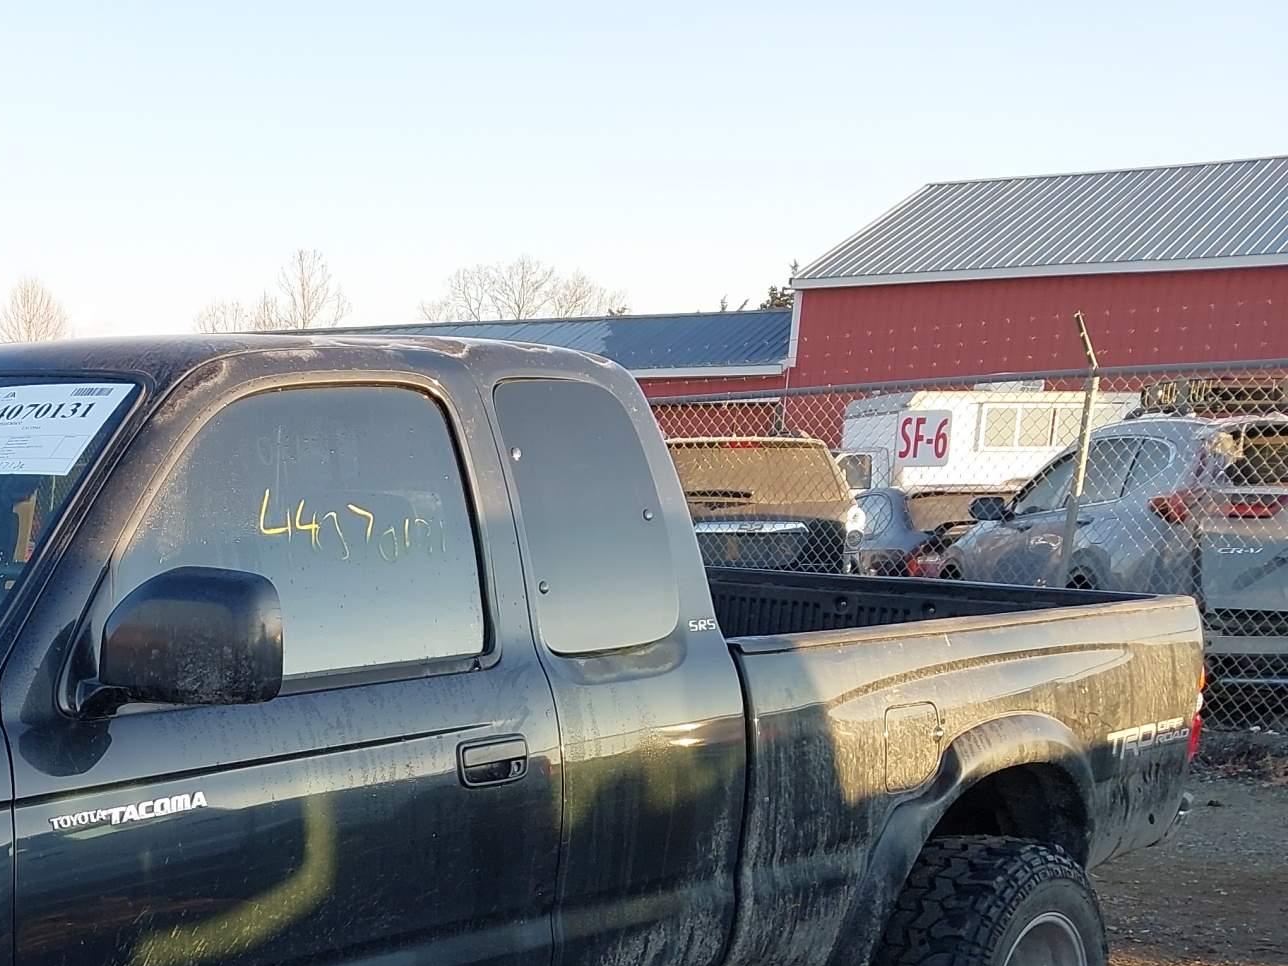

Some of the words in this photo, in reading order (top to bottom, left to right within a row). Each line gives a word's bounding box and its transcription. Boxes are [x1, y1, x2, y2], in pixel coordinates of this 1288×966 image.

[898, 416, 950, 459] SF-6
[1107, 722, 1156, 760] TRD
[1155, 728, 1190, 745] ROAD
[1157, 717, 1184, 734] OFF
[50, 809, 106, 830] TOYOTA
[107, 791, 208, 825] TACOMA
